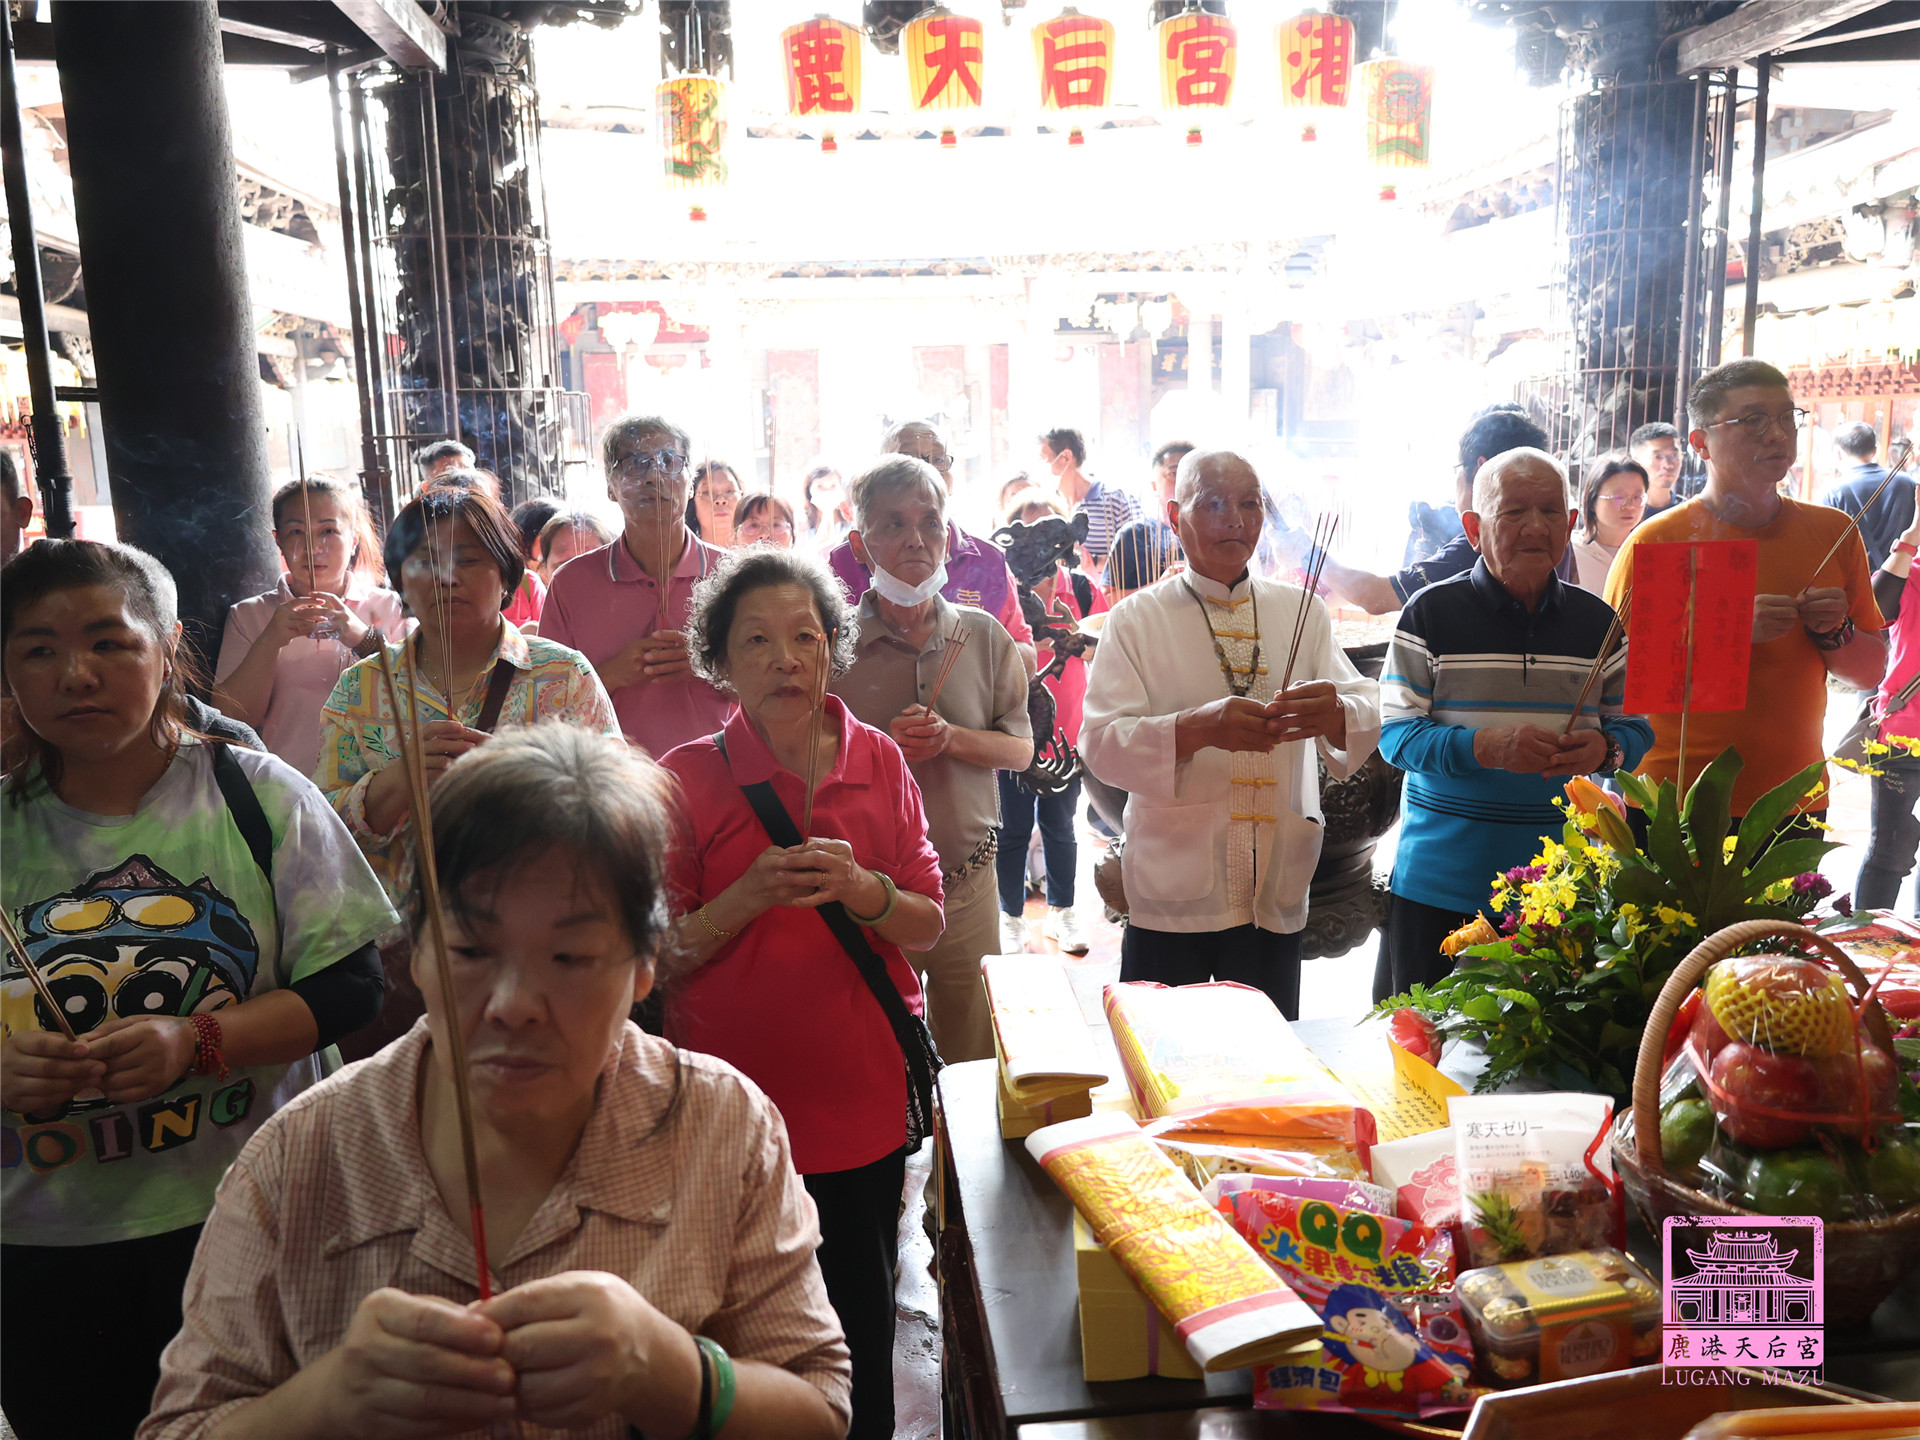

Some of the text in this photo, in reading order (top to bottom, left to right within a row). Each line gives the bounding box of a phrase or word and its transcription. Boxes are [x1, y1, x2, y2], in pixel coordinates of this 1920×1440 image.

[790, 24, 853, 115] 鹿
[919, 16, 983, 108] 天
[1041, 20, 1107, 109] 后
[1166, 16, 1237, 108] 宮
[1466, 1121, 1544, 1139] 寒天ゼリー
[1261, 1228, 1430, 1288] 水果軟糖
[1300, 1201, 1382, 1263] QQ
[1268, 1365, 1343, 1393] 經濟包
